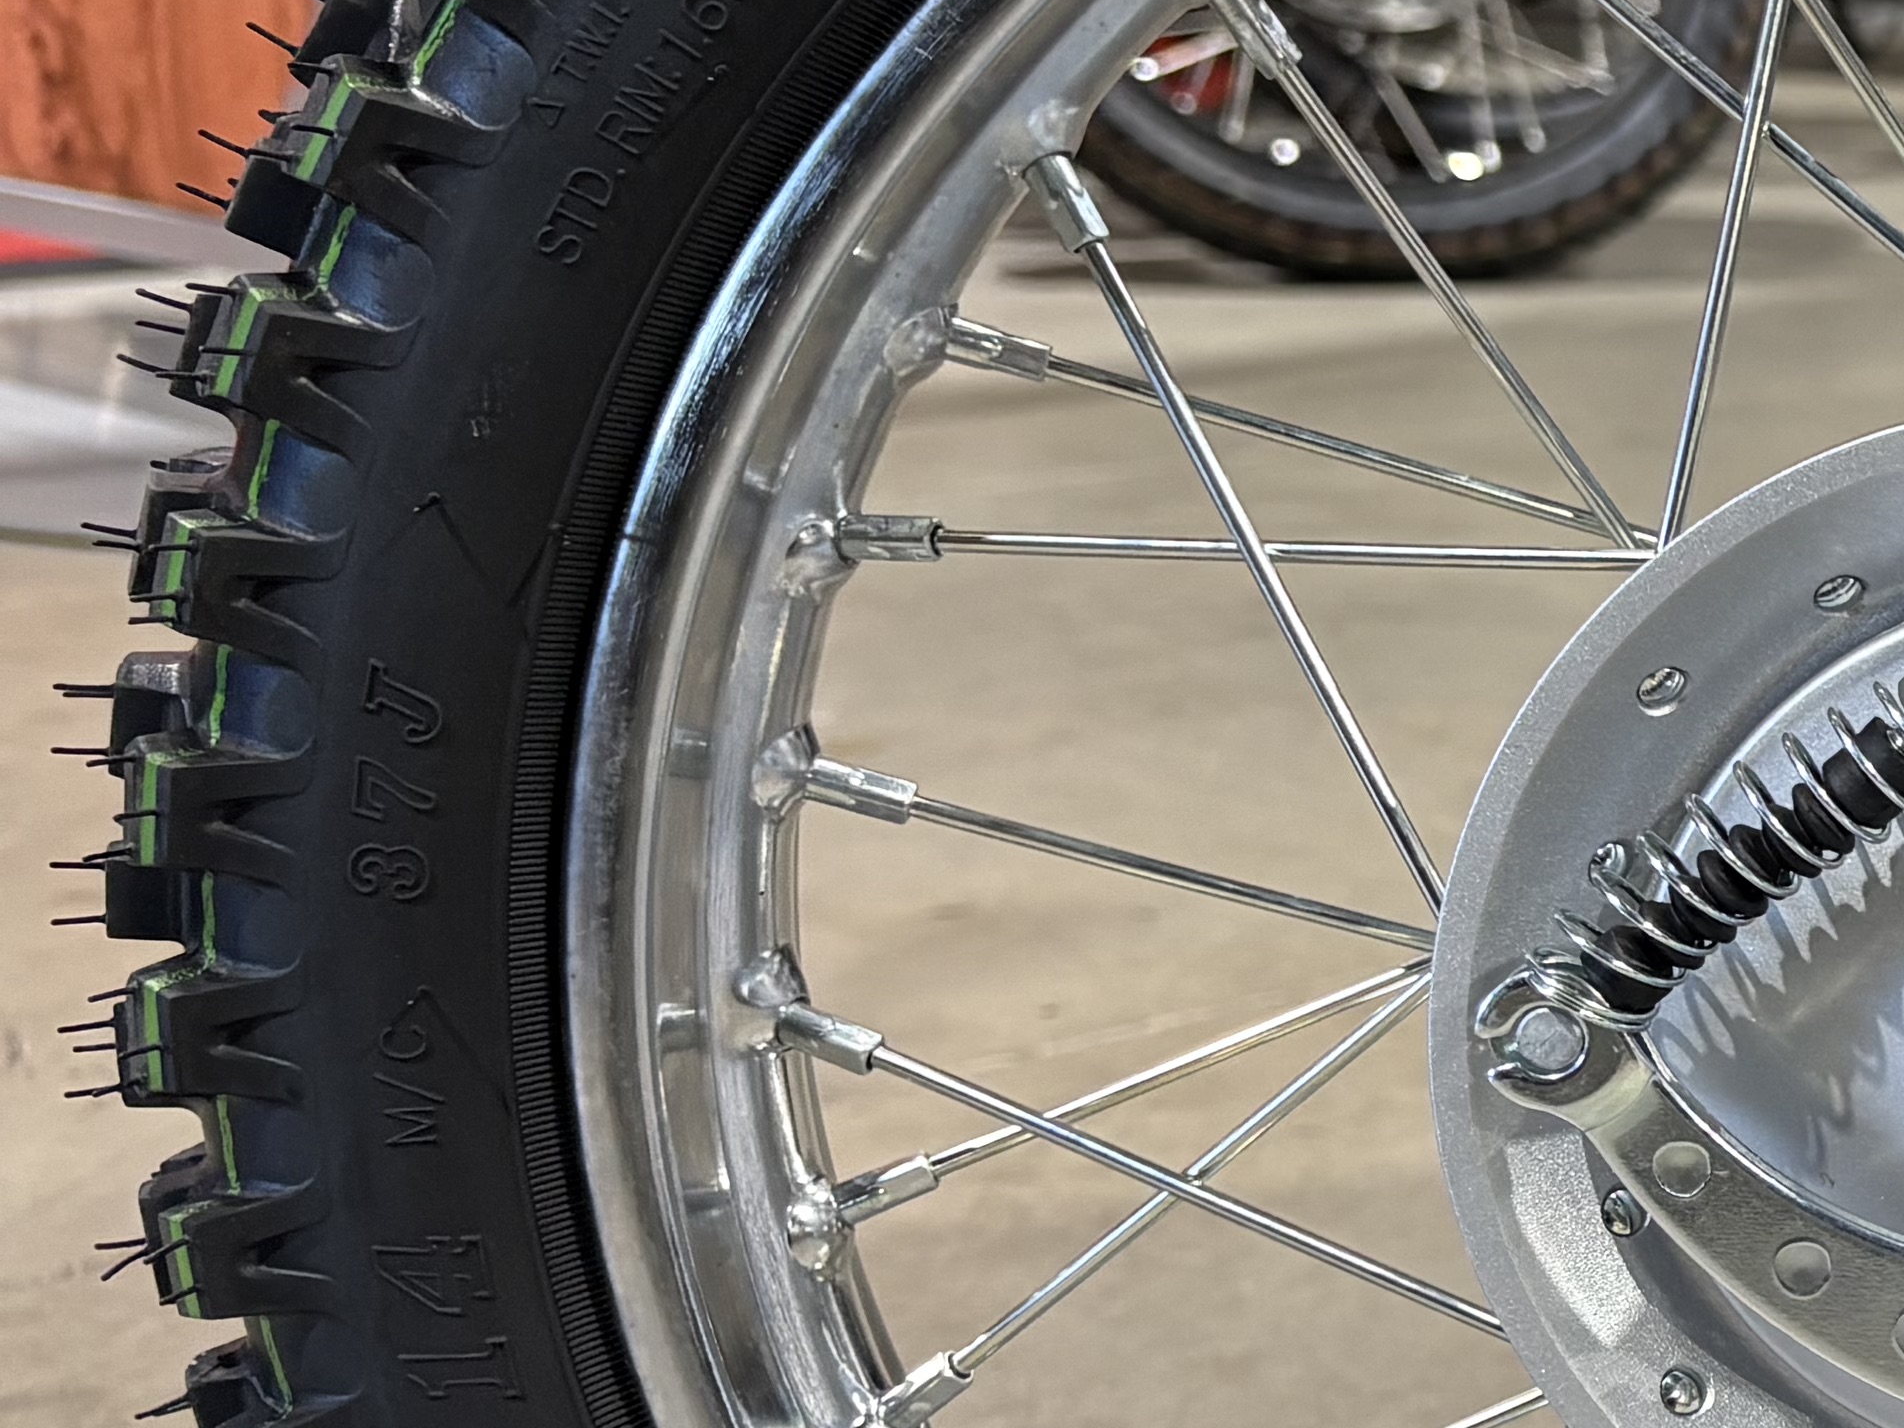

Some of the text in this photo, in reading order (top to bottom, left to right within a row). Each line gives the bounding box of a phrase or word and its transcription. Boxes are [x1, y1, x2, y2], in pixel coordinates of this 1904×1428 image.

[534, 165, 629, 266] STD.
[346, 657, 443, 902] 37J
[372, 1022, 448, 1149] M/C
